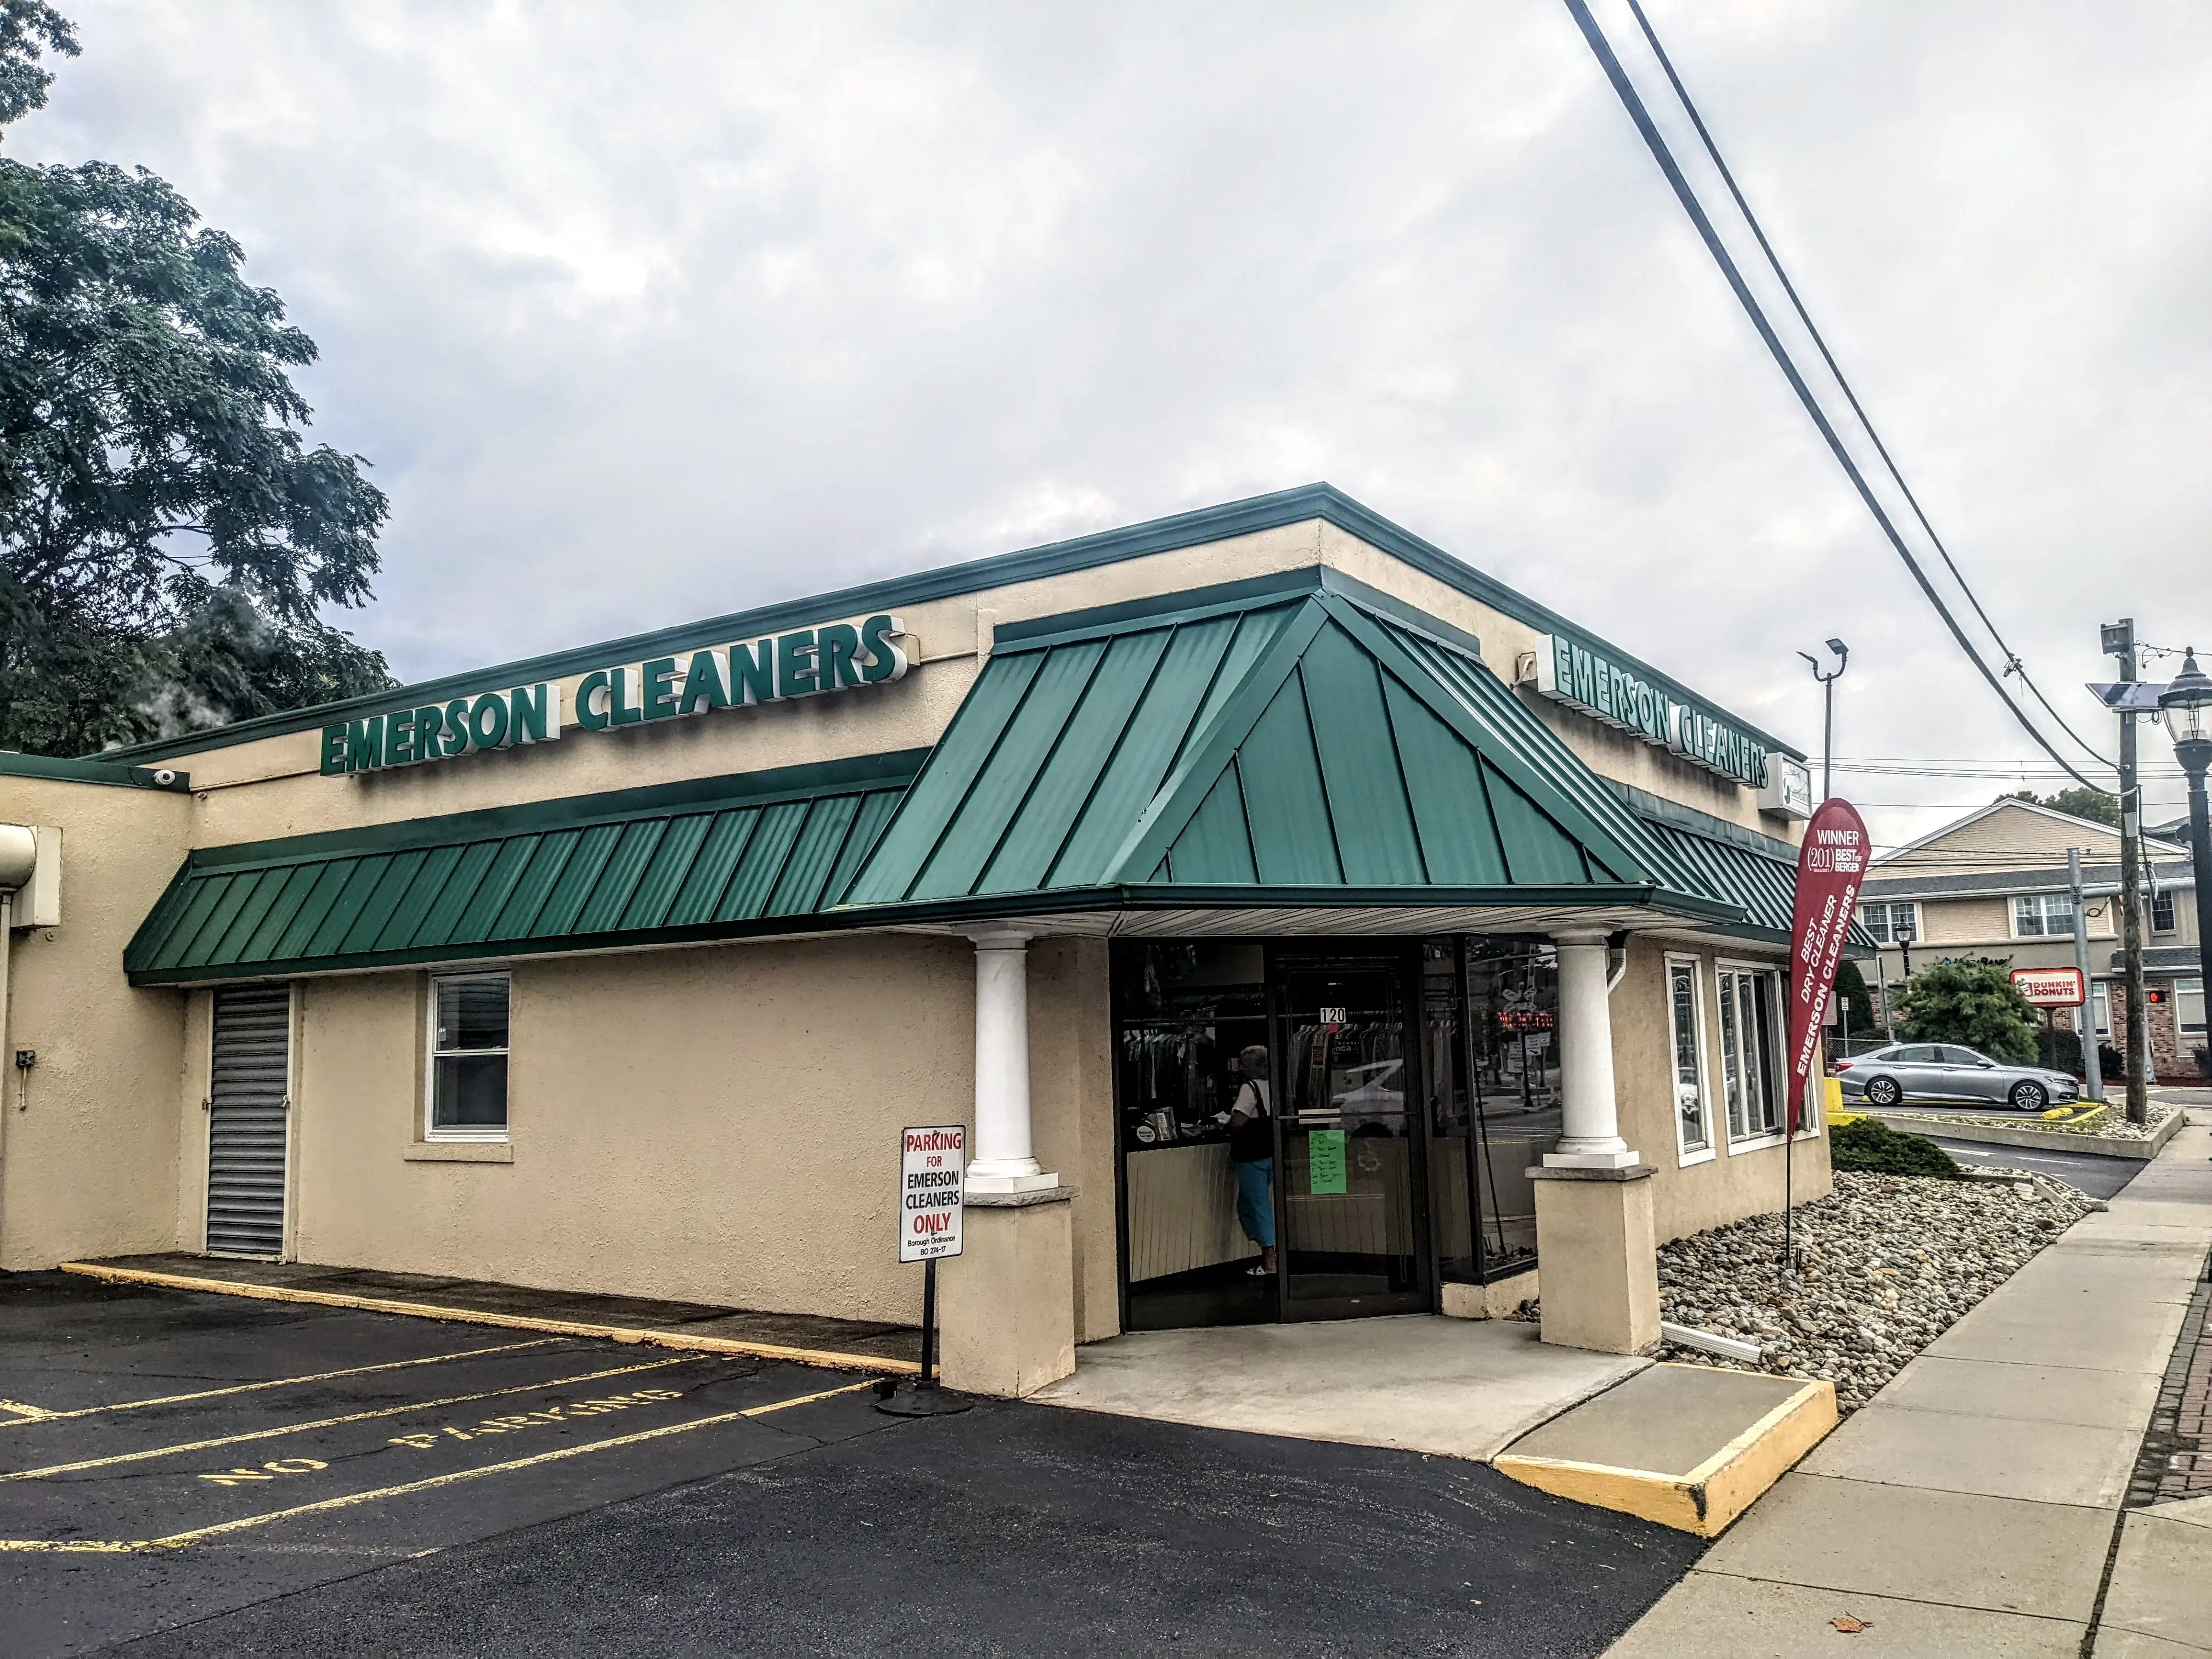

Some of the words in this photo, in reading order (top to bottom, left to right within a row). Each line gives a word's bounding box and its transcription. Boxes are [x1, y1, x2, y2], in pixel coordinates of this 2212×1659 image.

[320, 683, 554, 776] EMERSON
[575, 614, 904, 731] CLEANERS
[1552, 634, 1672, 744] EMERSON
[1679, 704, 1769, 789] CLEANERS
[1816, 829, 1859, 846] WINNER
[1807, 847, 1835, 872] (201)
[1835, 848, 1857, 862] BEST
[1801, 917, 1818, 963] BEST
[1801, 965, 1815, 1004] DRY
[1810, 894, 1837, 968] CLEANER
[1796, 982, 1829, 1076] EMERSON
[1822, 884, 1855, 980] CLEANERS
[2033, 980, 2076, 989] DUNKIN'
[2034, 988, 2075, 996] DONUTS
[1322, 1008, 1345, 1022] 120
[906, 1132, 962, 1153] PARKING
[926, 1155, 943, 1168] FOR
[907, 1170, 960, 1189] EMERSON
[906, 1190, 960, 1210] CLEANERS
[913, 1211, 952, 1235] ONLY
[907, 1238, 930, 1247] Borough
[930, 1235, 956, 1244] Ordinance
[921, 1248, 929, 1256] BO
[930, 1245, 946, 1254] 274-17
[198, 1458, 328, 1486] NO
[387, 1389, 684, 1449] PARKING
